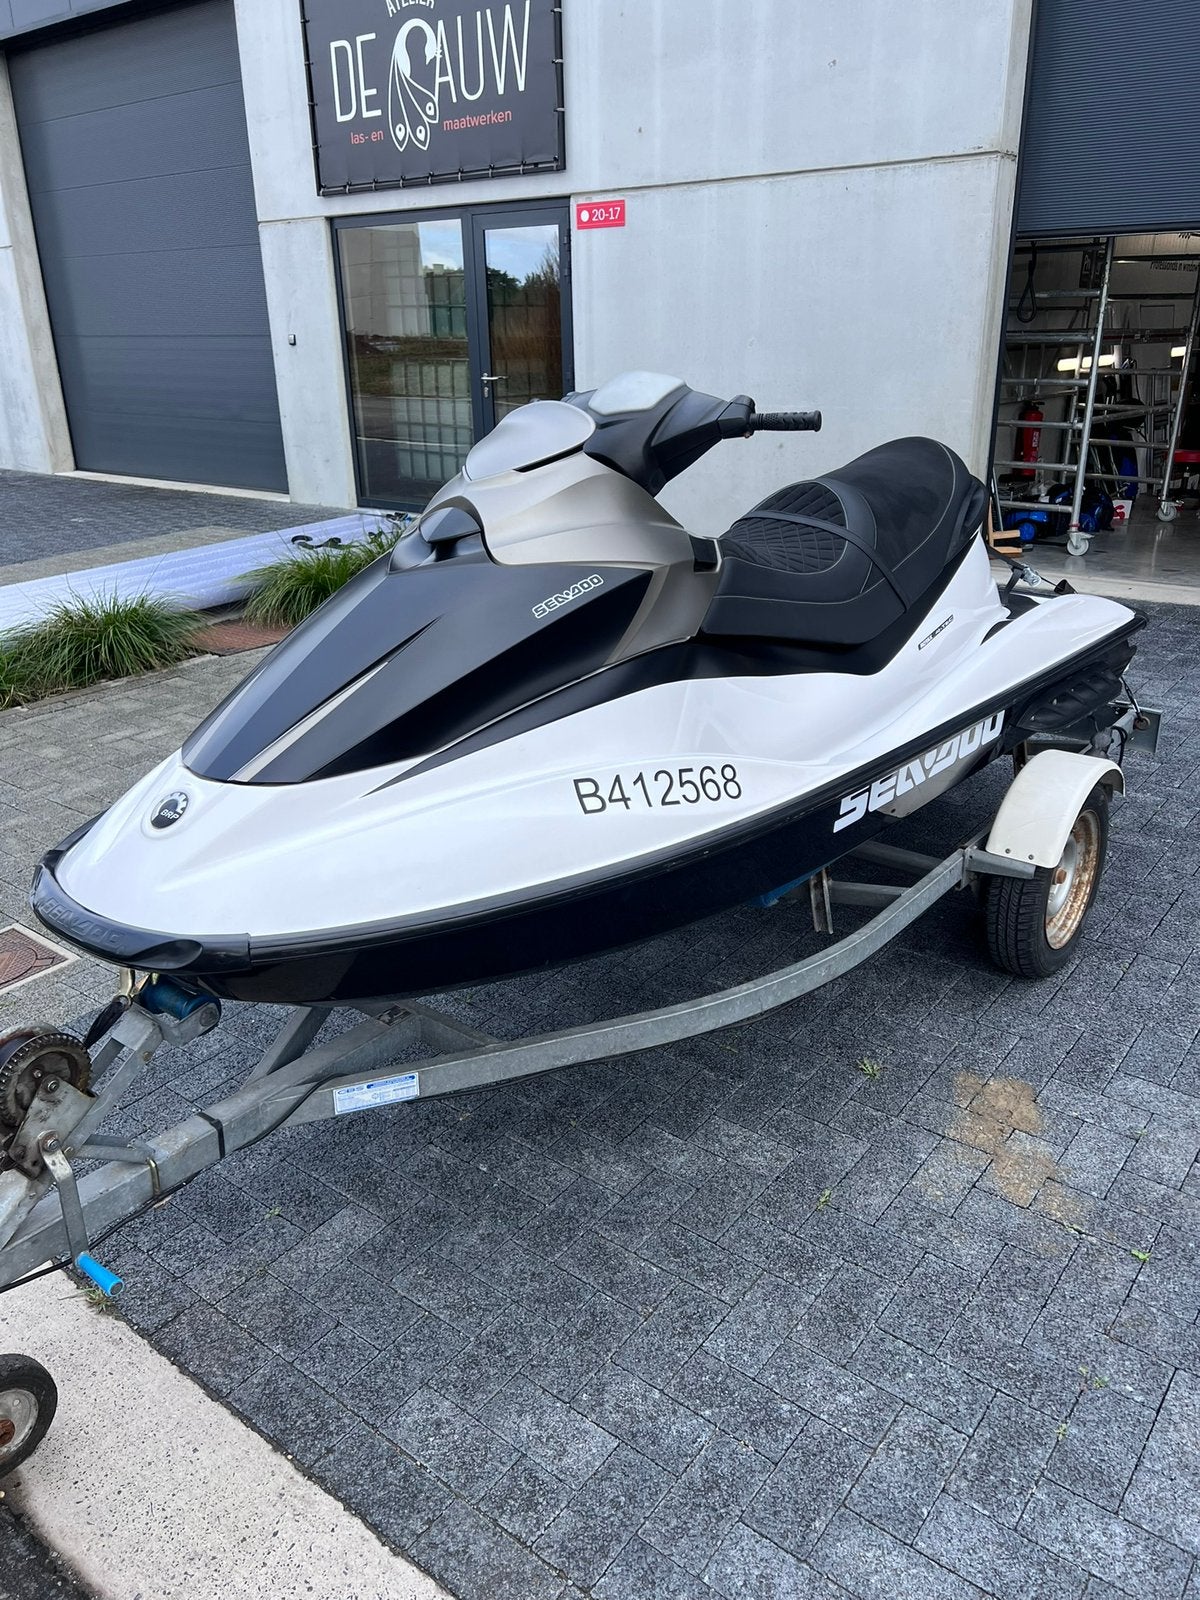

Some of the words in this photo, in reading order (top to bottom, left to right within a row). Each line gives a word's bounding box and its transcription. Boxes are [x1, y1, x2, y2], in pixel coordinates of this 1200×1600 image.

[329, 33, 382, 123] DE
[350, 132, 369, 145] las-
[371, 130, 384, 142] en
[443, 109, 512, 131] maatwerken
[591, 207, 621, 222] 20-17
[573, 763, 742, 815] B412568
[160, 808, 180, 820] BRP
